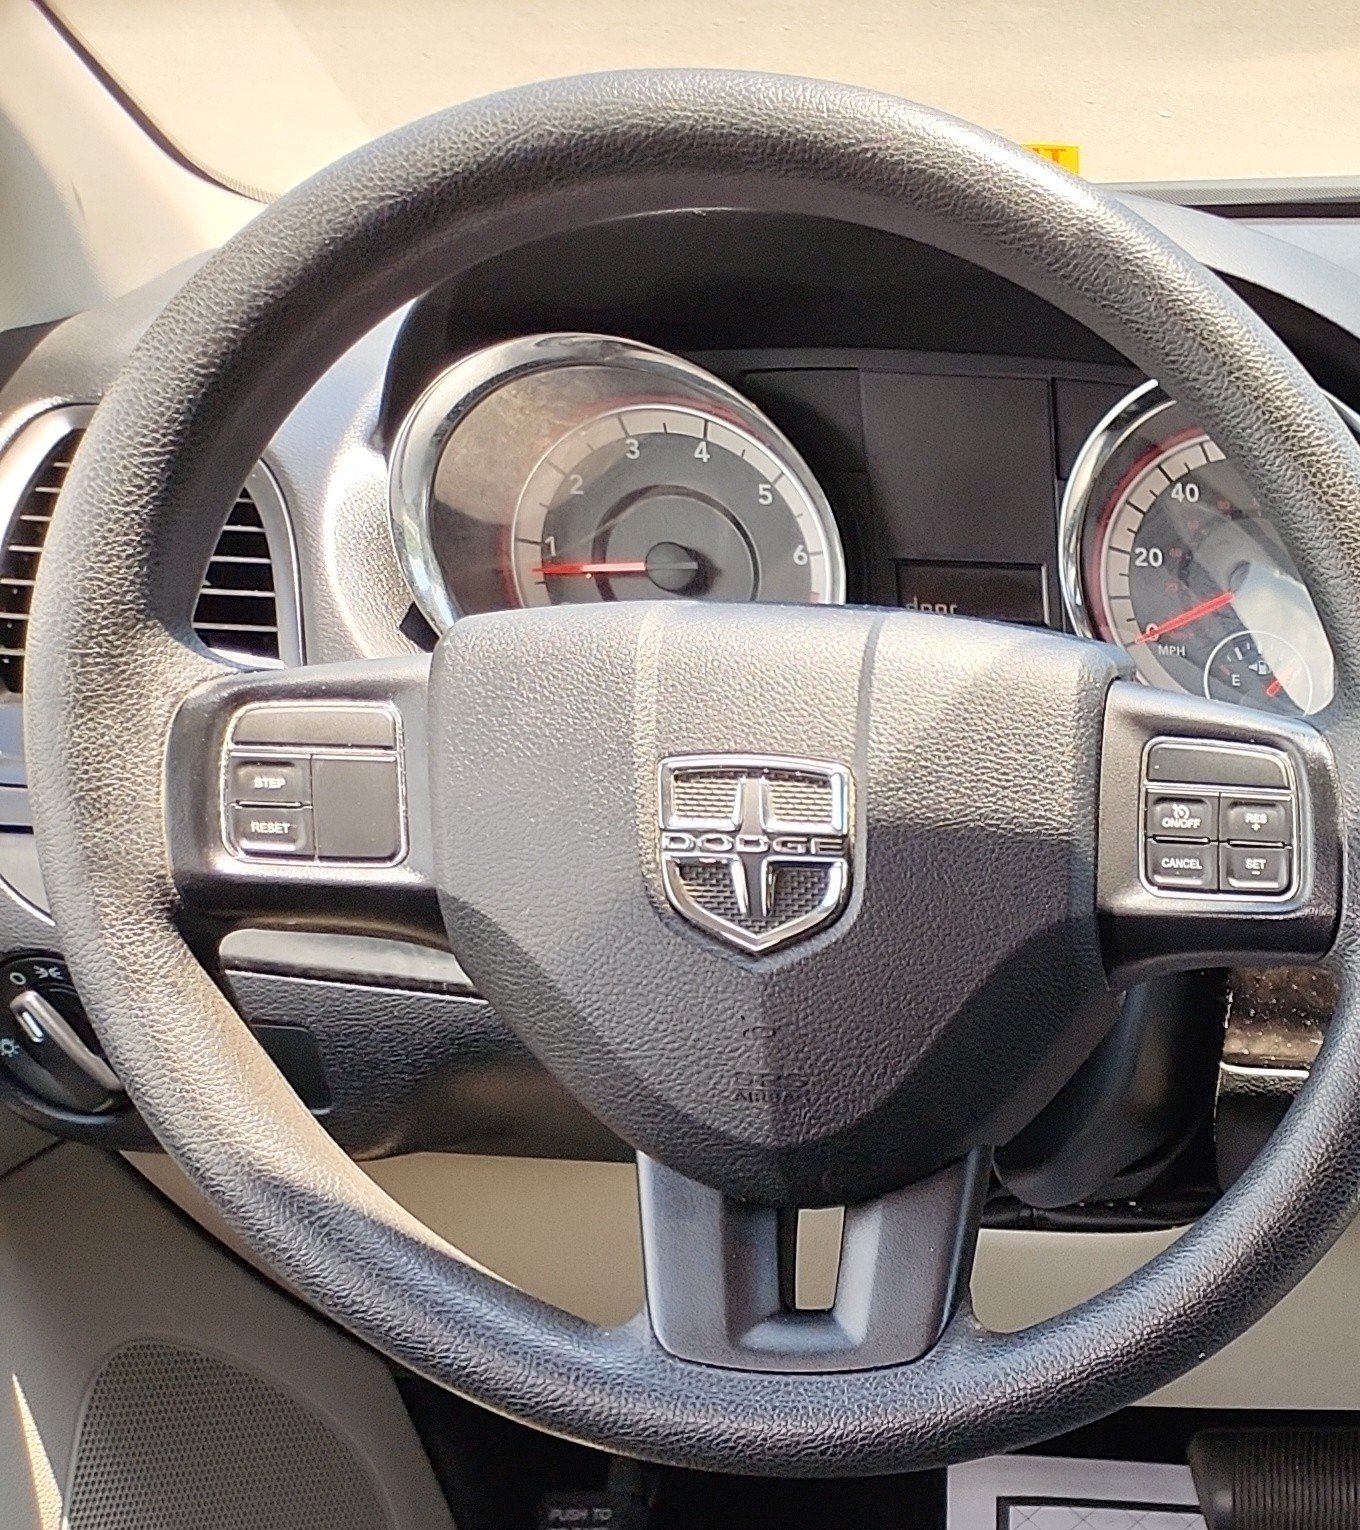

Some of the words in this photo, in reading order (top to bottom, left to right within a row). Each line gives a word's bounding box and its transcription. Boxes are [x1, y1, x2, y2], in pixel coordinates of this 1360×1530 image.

[624, 439, 641, 460] 3
[693, 441, 711, 464] 4
[570, 474, 585, 496] 2
[758, 484, 774, 506] 5
[1171, 482, 1200, 502] 40
[545, 535, 558, 558] 1
[793, 544, 808, 566] 6
[1134, 547, 1163, 568] 20
[1158, 644, 1186, 657] MPH
[1231, 674, 1241, 687] E
[253, 777, 286, 789] STEP
[250, 822, 291, 834] RESET
[1162, 818, 1201, 829] ON/OFF
[1245, 813, 1267, 824] RES
[663, 833, 845, 854] DODGE
[1161, 857, 1203, 870] CANCEL
[1245, 858, 1266, 870] SET
